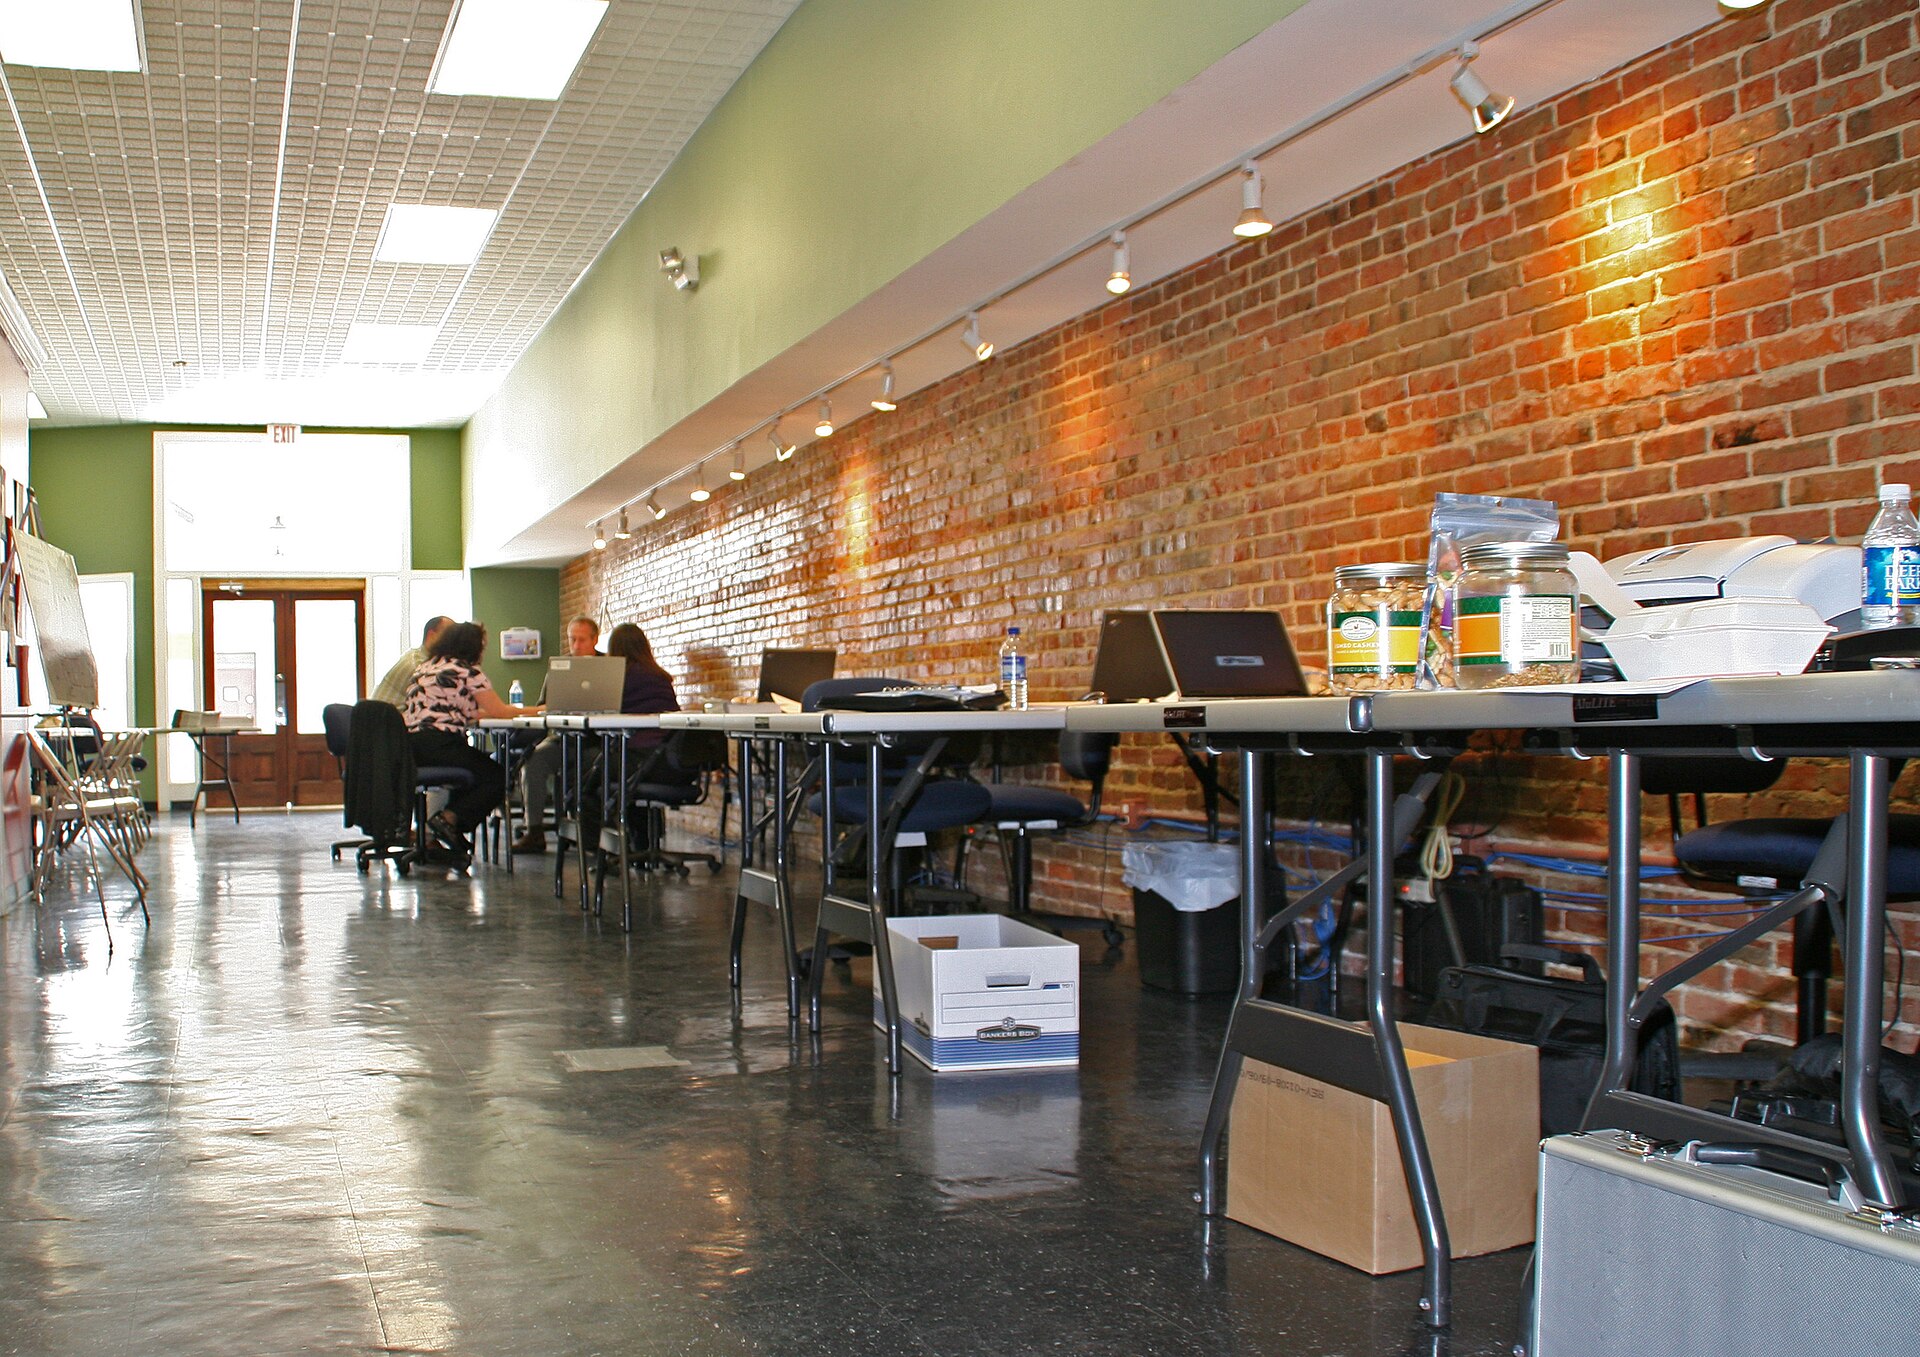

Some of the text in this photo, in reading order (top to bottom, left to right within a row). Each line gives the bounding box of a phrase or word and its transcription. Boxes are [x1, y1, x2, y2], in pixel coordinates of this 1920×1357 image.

[273, 425, 296, 443] EXIT
[1885, 577, 1920, 590] PAR
[980, 1031, 1017, 1039] BANKERS
